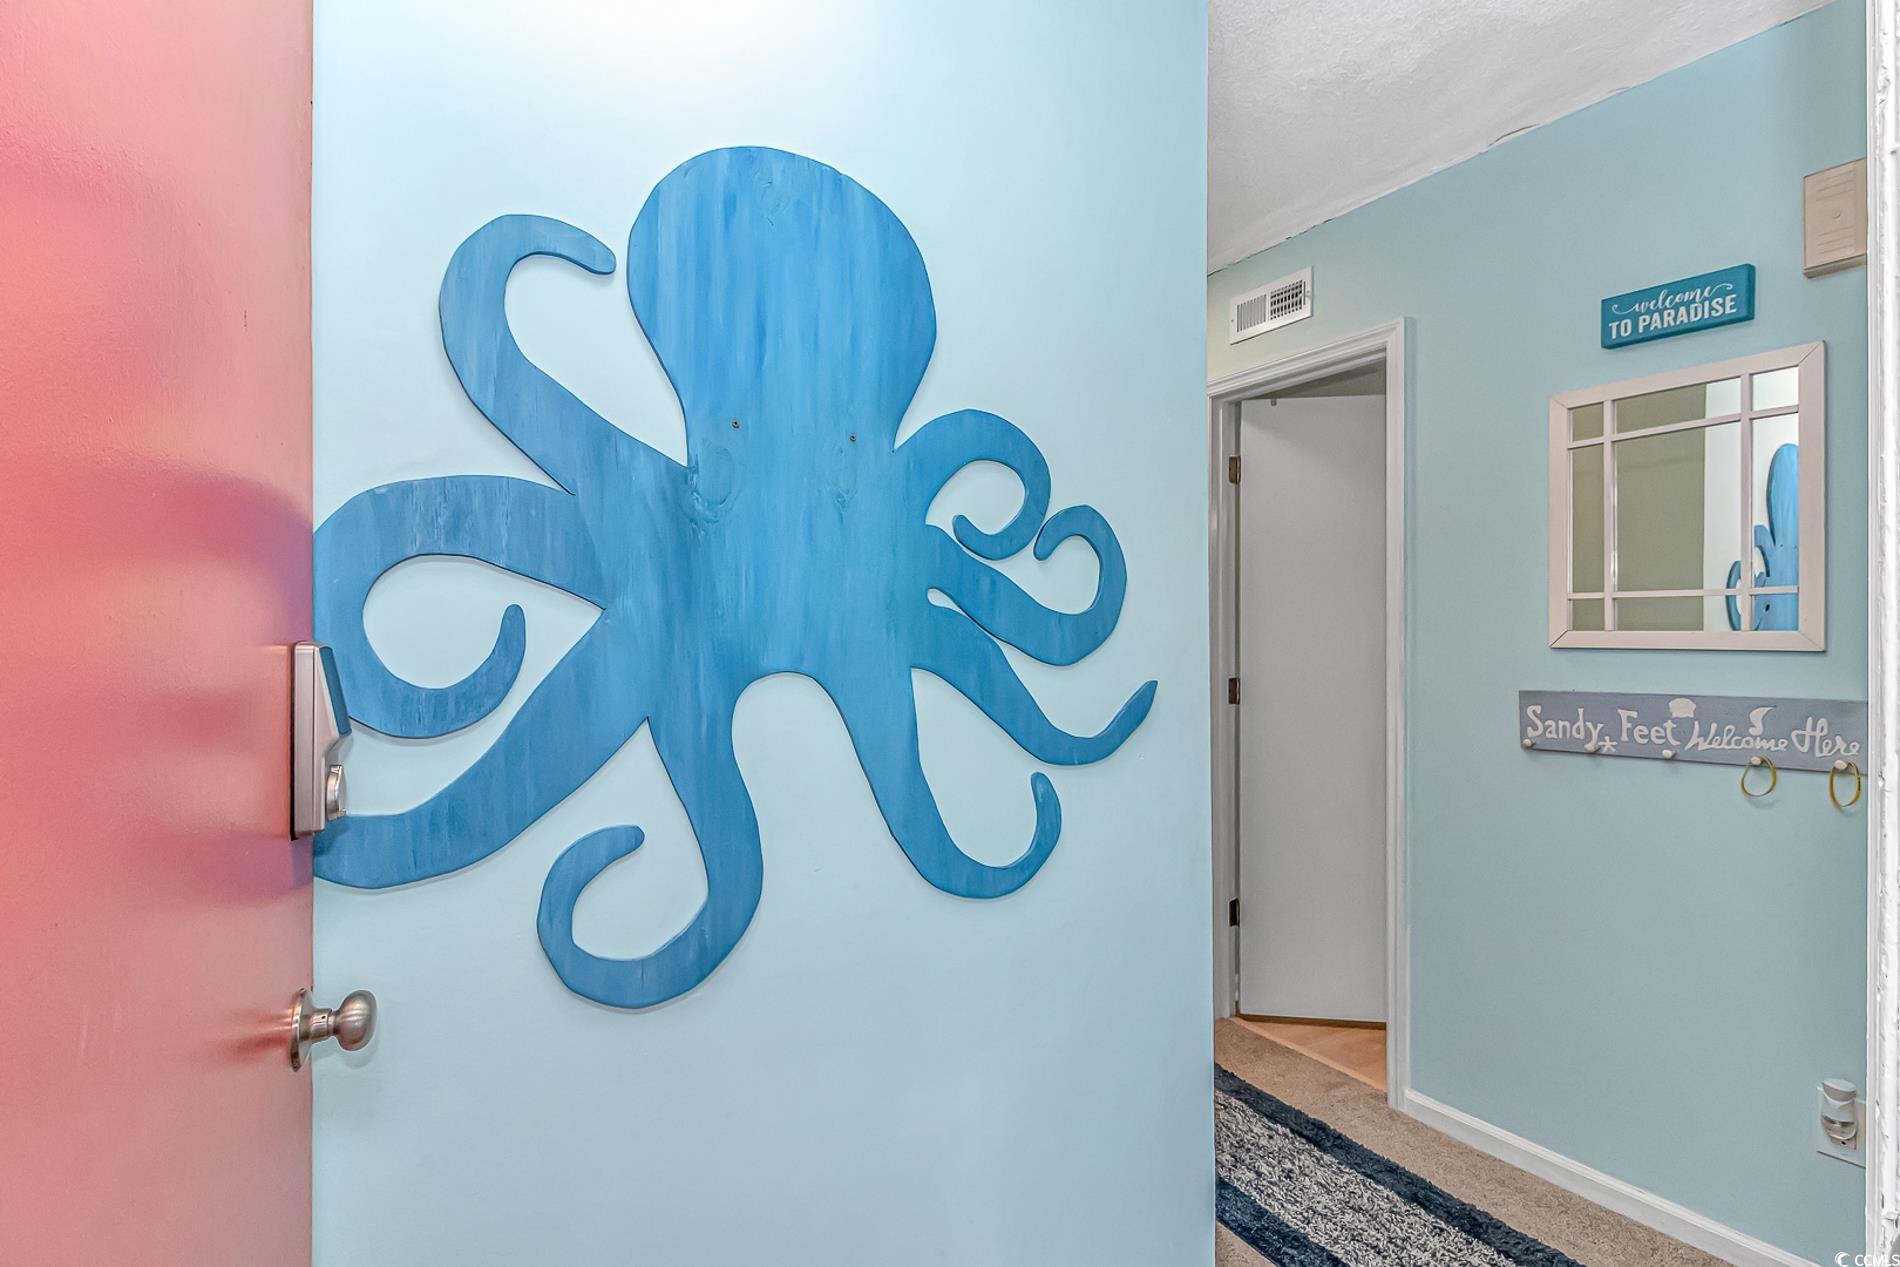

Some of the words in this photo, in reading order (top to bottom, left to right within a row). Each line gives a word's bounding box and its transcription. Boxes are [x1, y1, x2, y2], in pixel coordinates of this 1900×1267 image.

[1609, 318, 1632, 339] TO
[1638, 294, 1737, 333] PARADISE
[1612, 283, 1733, 315] welcome
[1526, 704, 1604, 751] Sandy
[1617, 708, 1681, 745] Feet
[1685, 719, 1789, 752] Welcome
[1791, 716, 1861, 758] Here
